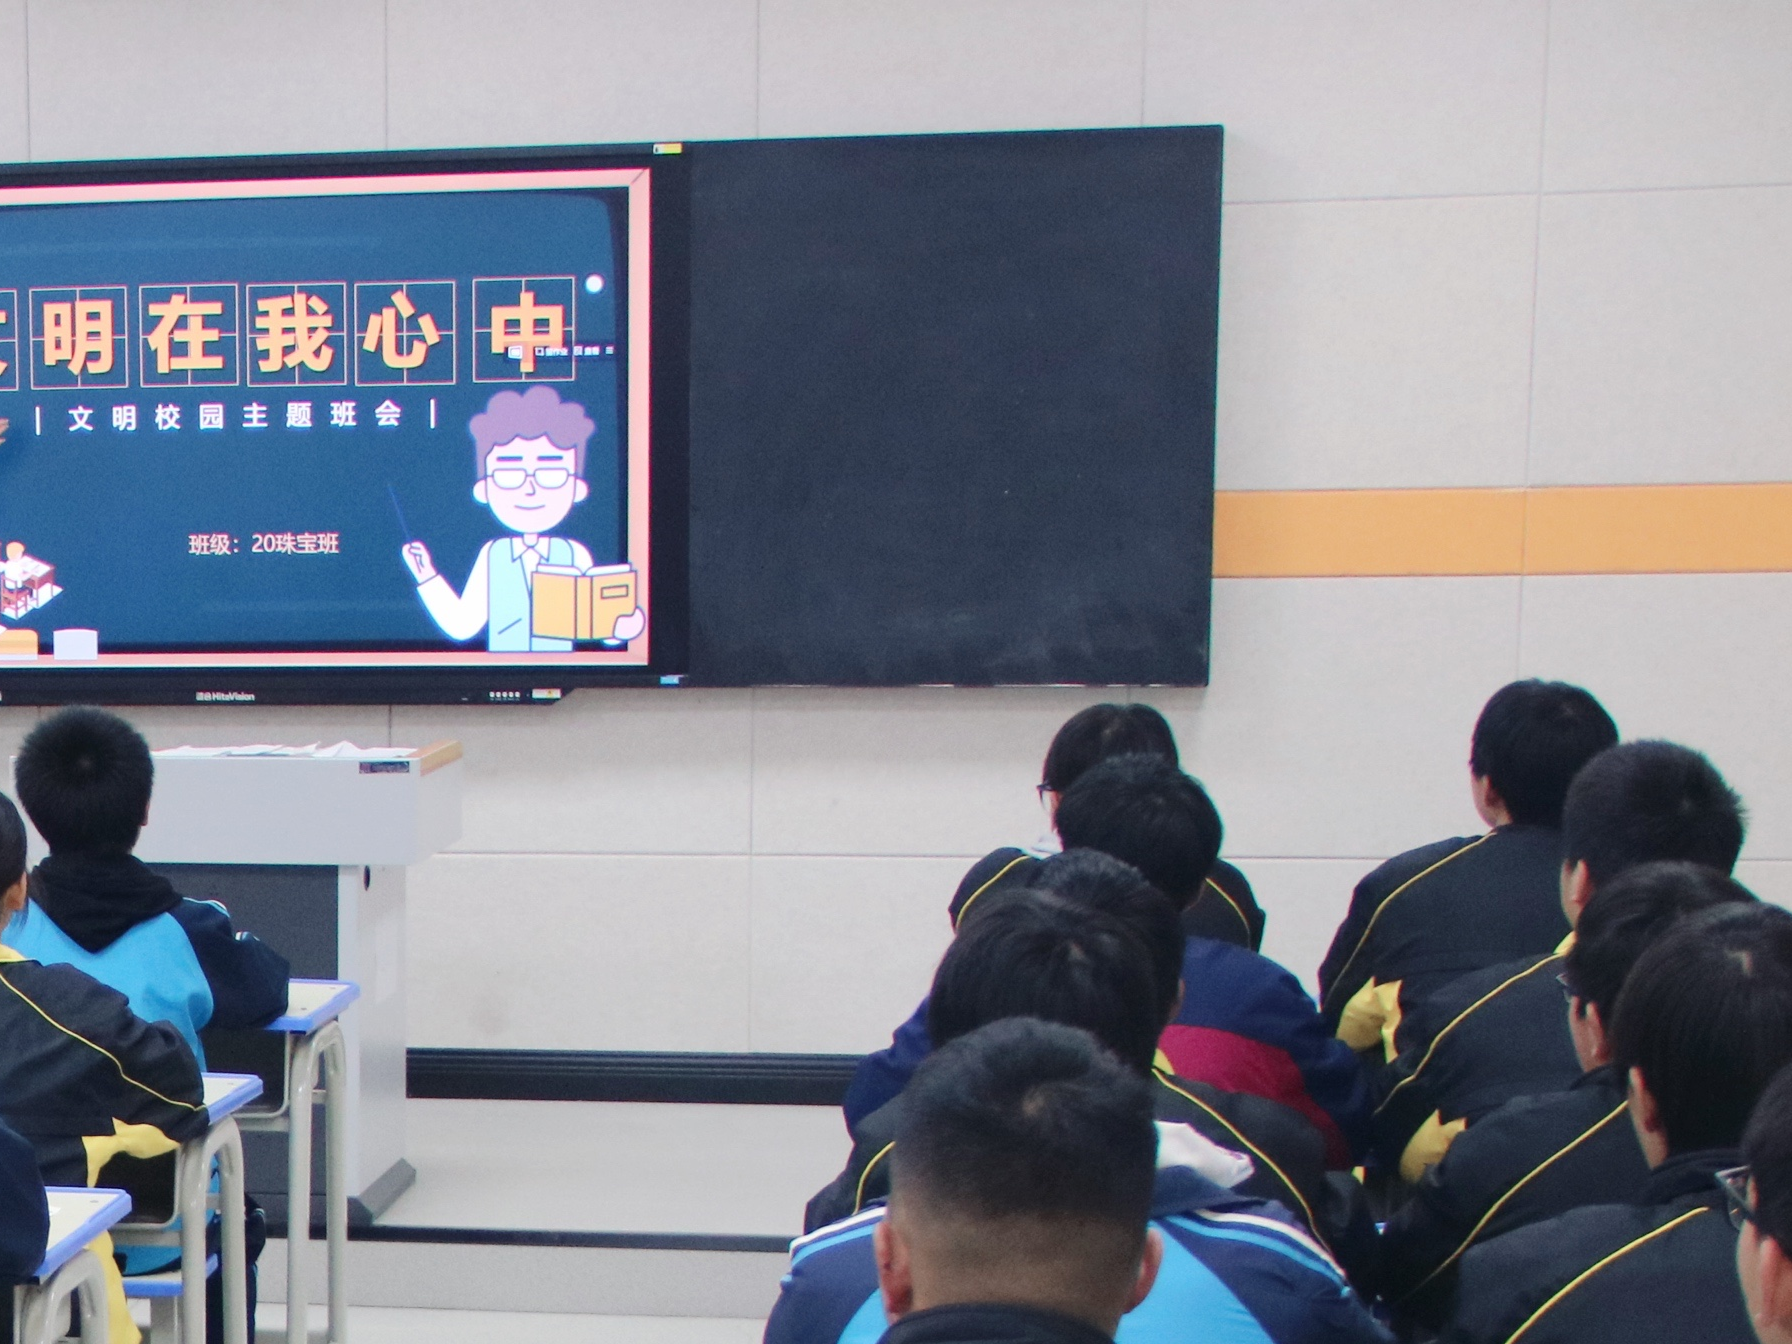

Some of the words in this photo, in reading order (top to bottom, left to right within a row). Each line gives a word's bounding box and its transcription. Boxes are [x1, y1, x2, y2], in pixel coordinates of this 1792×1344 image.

[68, 401, 401, 432] 文明校园主题班会
